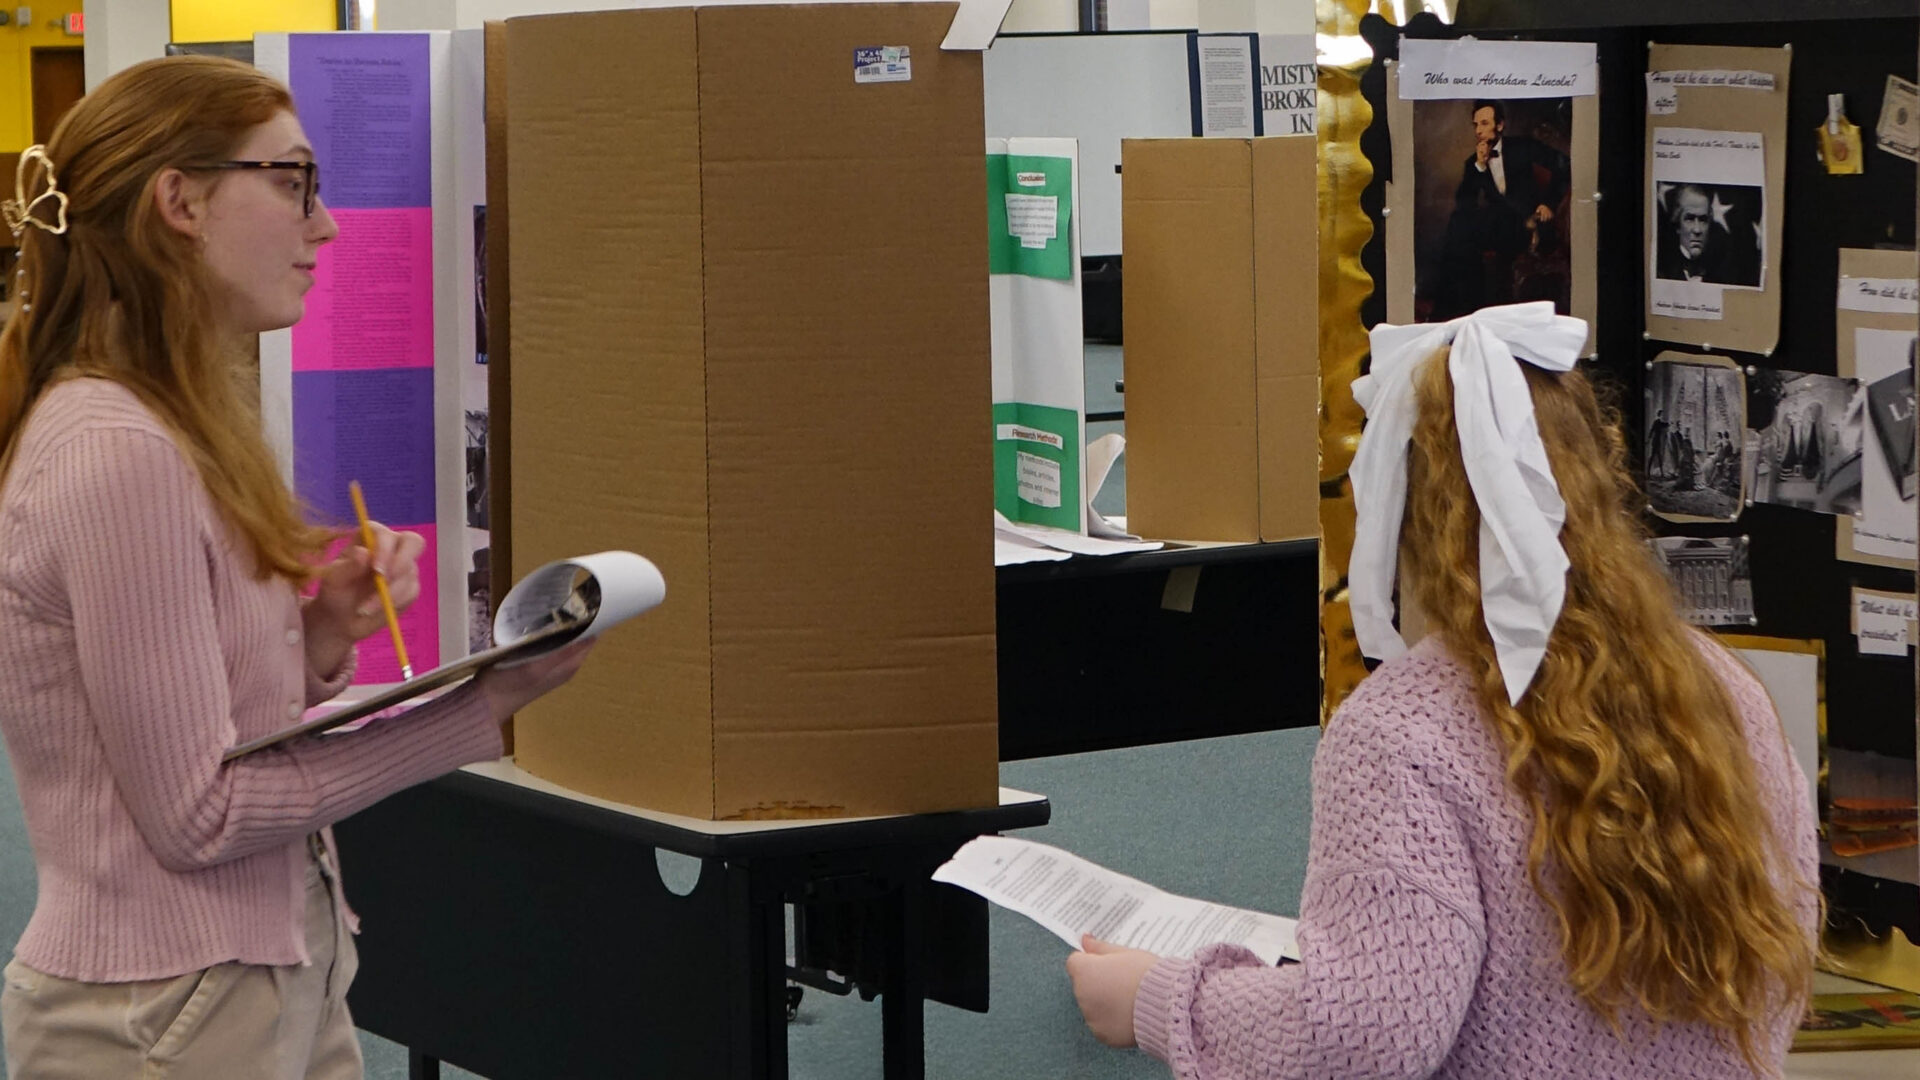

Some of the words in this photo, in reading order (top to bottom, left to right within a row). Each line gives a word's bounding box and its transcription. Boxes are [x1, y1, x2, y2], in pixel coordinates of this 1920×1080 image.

[857, 56, 881, 64] Project
[1262, 63, 1317, 86] MISTY
[1424, 72, 1450, 85] Who
[1453, 77, 1474, 86] was
[1477, 72, 1528, 86] Abraham
[1531, 73, 1578, 87] Lincoln?
[1290, 113, 1314, 134] IN
